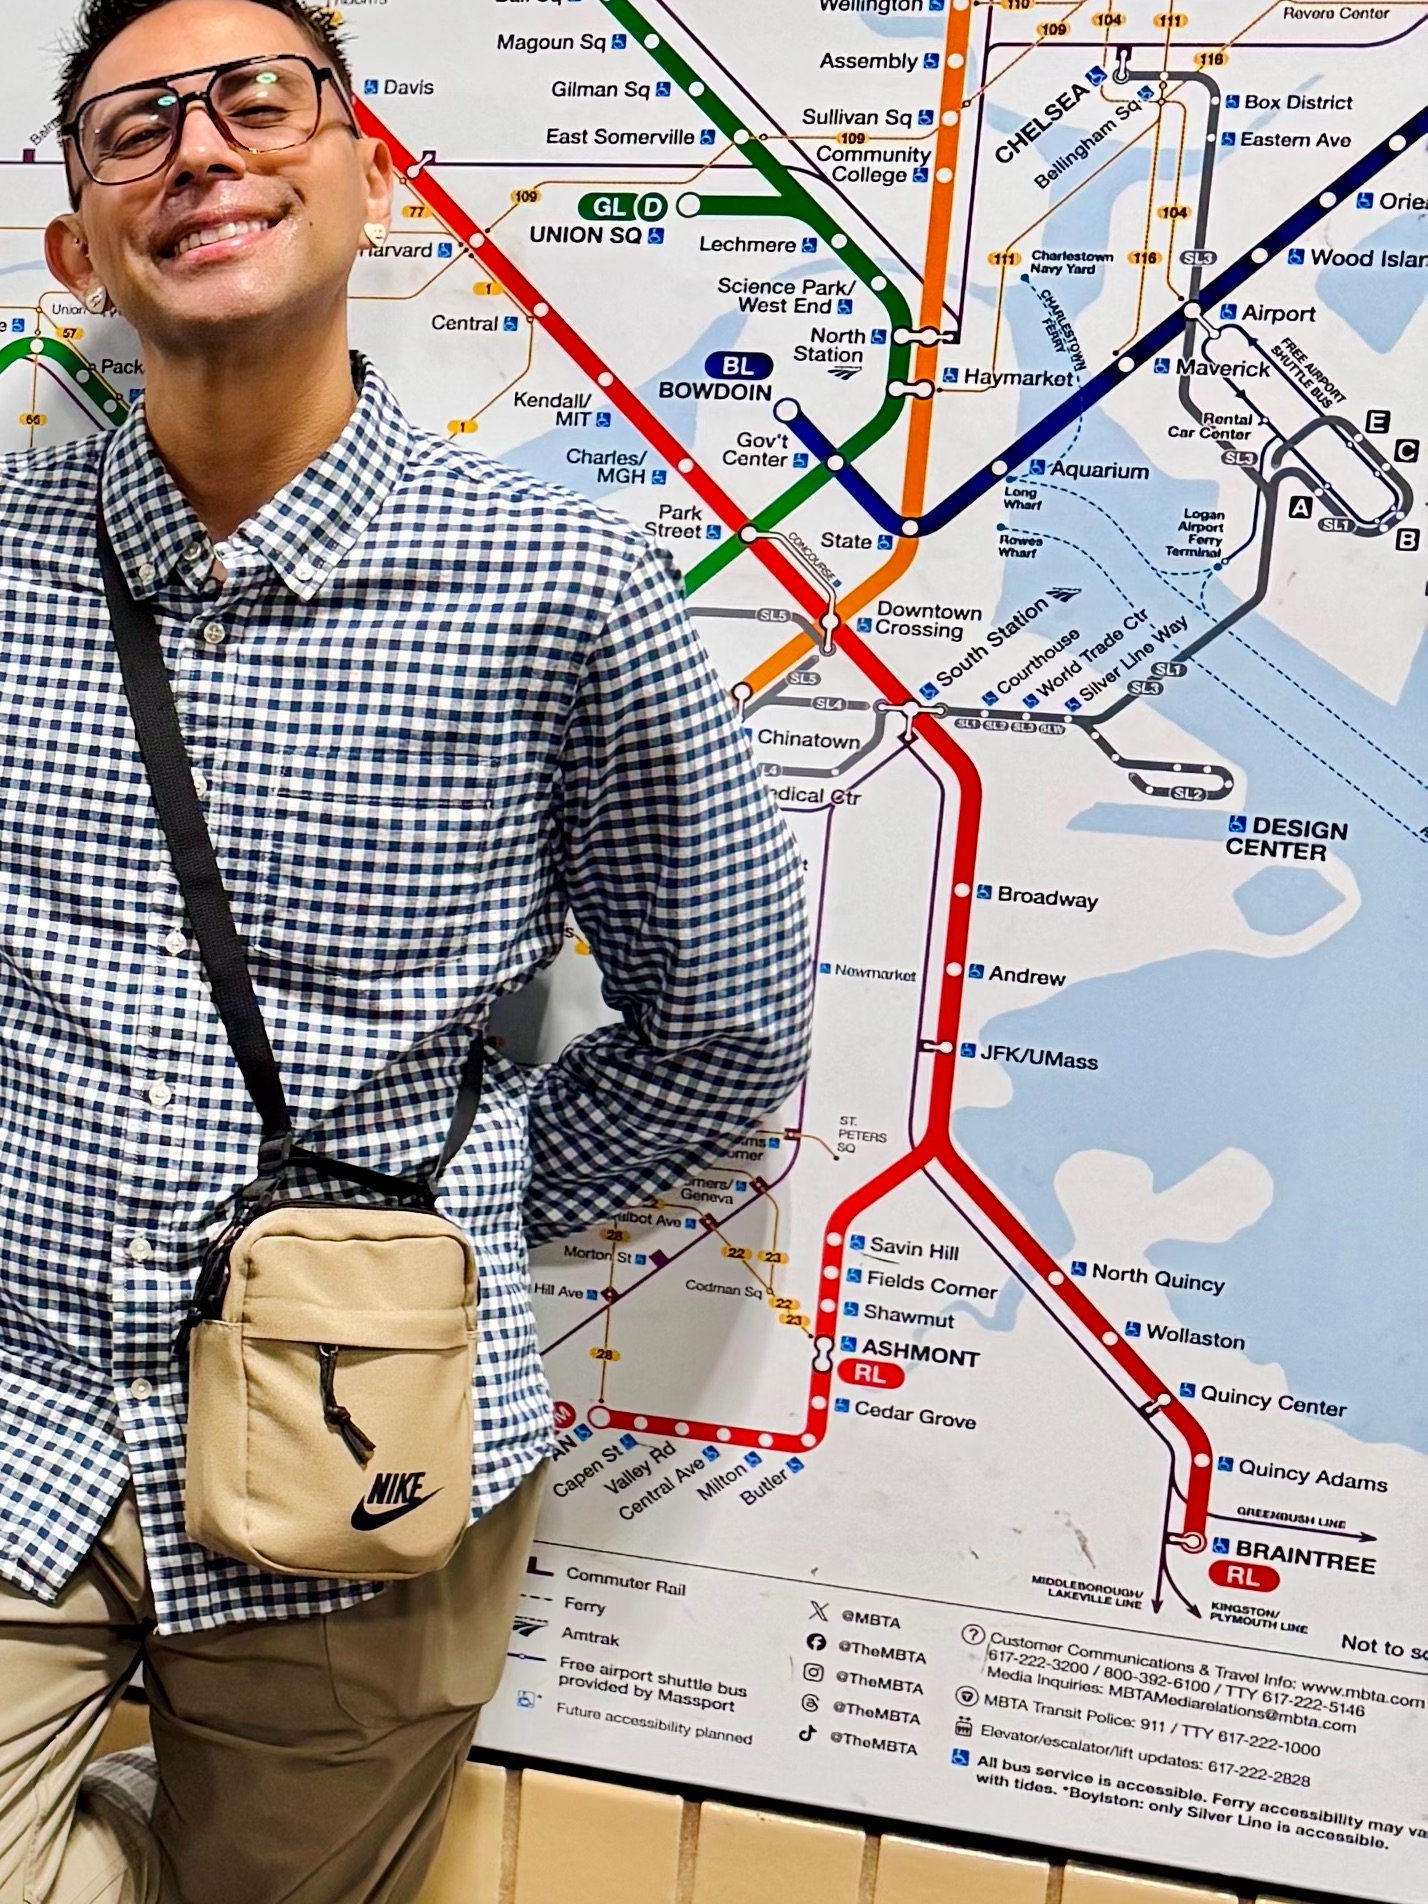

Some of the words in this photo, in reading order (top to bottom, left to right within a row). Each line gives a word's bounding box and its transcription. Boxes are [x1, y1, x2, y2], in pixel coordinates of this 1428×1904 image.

[498, 34, 573, 53] Magoun
[580, 34, 606, 53] Sq
[820, 53, 918, 73] Assembly
[384, 80, 433, 94] Davis
[552, 81, 617, 97] Gilman
[625, 81, 650, 100] Sq
[802, 108, 878, 125] Sullivan
[885, 109, 912, 129] Sq
[995, 84, 1089, 165] CHELSEA
[547, 128, 588, 144] East
[594, 128, 694, 144] Somerville
[817, 145, 931, 168] Community
[832, 166, 906, 187] College
[594, 197, 626, 216] GL
[531, 226, 603, 243] UNION
[610, 227, 642, 244] SQ
[700, 236, 796, 253] Lechmere
[432, 315, 498, 331] Central
[1242, 305, 1316, 325] Airport
[811, 328, 865, 349] North
[794, 345, 863, 362] Station
[723, 357, 754, 375] BL
[1176, 358, 1271, 379] Maverick
[965, 369, 1073, 389] Haymarket
[515, 392, 592, 409] Kendall/
[659, 382, 771, 401] BOWDOIN
[556, 411, 592, 426] MIT
[737, 432, 788, 449] Gov't
[567, 449, 647, 469] Charles/
[723, 450, 788, 467] Center
[598, 468, 645, 484] MGH
[1050, 460, 1149, 480] Aquarium
[659, 504, 701, 520] Park
[642, 522, 701, 539] Street
[821, 532, 872, 549] State
[877, 601, 982, 623] Downtown
[876, 619, 963, 642] Crossing
[937, 647, 988, 686] South
[987, 599, 1048, 647] Station
[758, 729, 861, 751] Chinatown
[1253, 817, 1349, 841] DESIGN
[1226, 838, 1326, 861] CENTER
[999, 886, 1098, 912] Broadway
[989, 966, 1066, 986] Andrew
[981, 1045, 1098, 1070] JFK/UMass
[871, 1237, 922, 1256] Savin
[930, 1244, 959, 1260] Hill
[868, 1271, 924, 1290] Fields
[931, 1278, 998, 1299] Corner
[1093, 1263, 1147, 1284] North
[1155, 1271, 1225, 1296] Quincy
[864, 1304, 954, 1328] Shawmut
[1147, 1324, 1245, 1350] Wollaston
[862, 1339, 981, 1368] ASHMONT
[855, 1363, 886, 1383] RL
[1202, 1386, 1272, 1411] Quincy
[1278, 1395, 1347, 1417] Center
[856, 1401, 914, 1421] Cedar
[920, 1410, 976, 1429] Grove
[1240, 1459, 1310, 1485] Quincy
[1315, 1470, 1387, 1492] Adams
[367, 1472, 425, 1504] NIKE
[1236, 1540, 1376, 1576] BRAINTREE
[567, 1567, 652, 1592] Commuter
[656, 1580, 685, 1596] Rail
[1227, 1566, 1259, 1586] RL
[565, 1597, 605, 1616] Ferry
[843, 1611, 900, 1629] @MBTA
[562, 1627, 619, 1646] Amtrak
[839, 1641, 926, 1664] @TheMBTA
[1138, 1750, 1204, 1773] updates:
[1208, 1760, 1311, 1788] 617-222-2828
